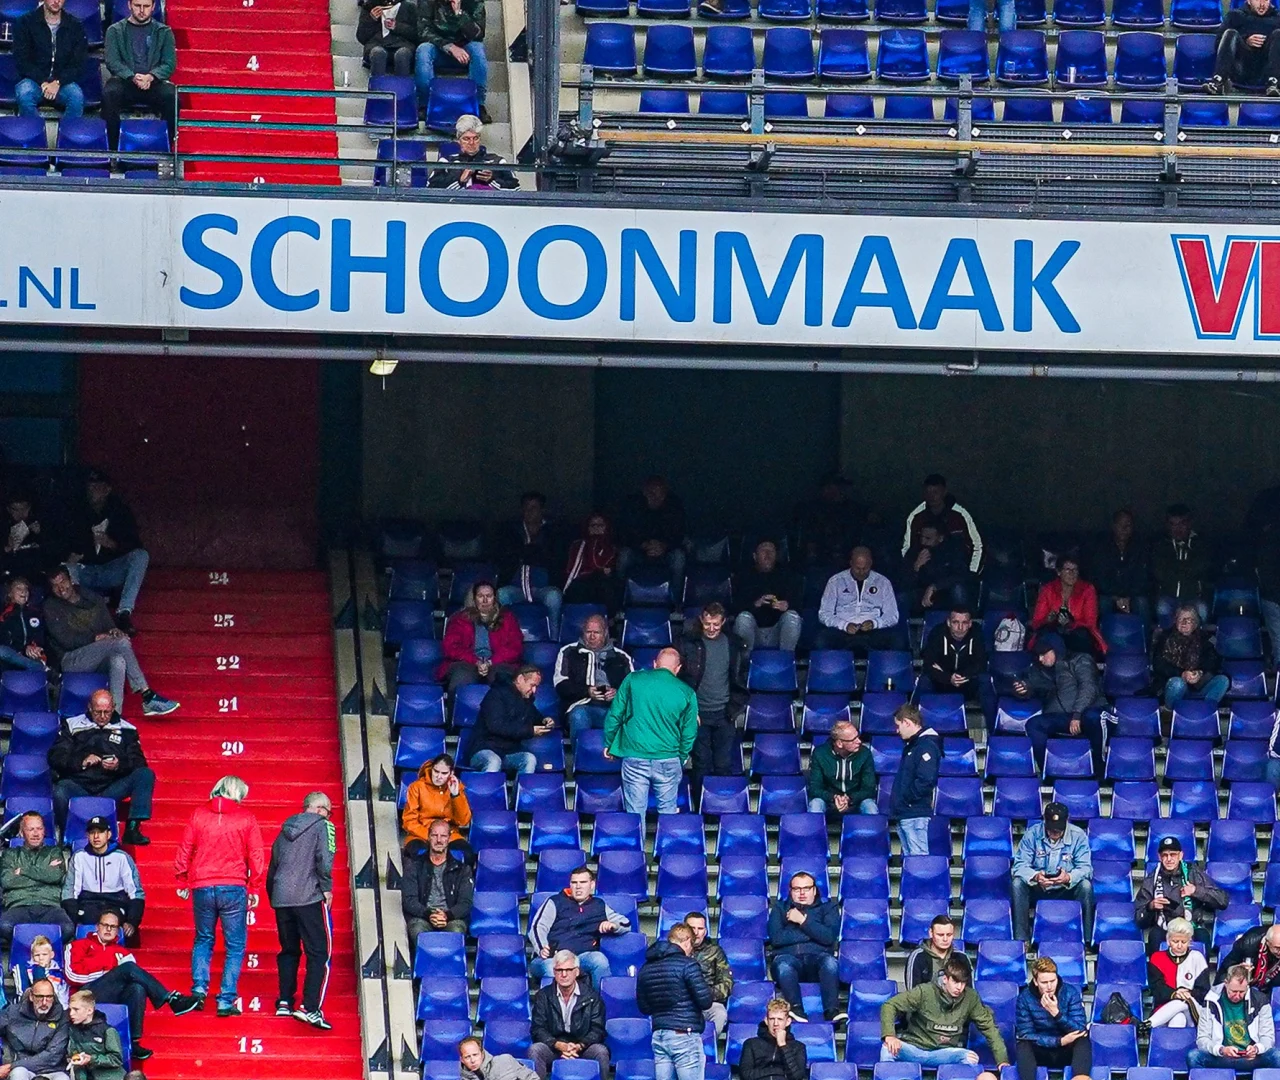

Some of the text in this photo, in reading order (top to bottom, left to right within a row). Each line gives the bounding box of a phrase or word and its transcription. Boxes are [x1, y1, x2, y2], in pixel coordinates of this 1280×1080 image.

[246, 55, 260, 72] 4
[179, 213, 1082, 334] SCHOONMAAK
[208, 571, 229, 585] 24
[216, 655, 240, 671] 22
[218, 697, 239, 713] 21
[221, 741, 244, 756] 20
[234, 996, 261, 1013] 14
[236, 1035, 263, 1054] 13
